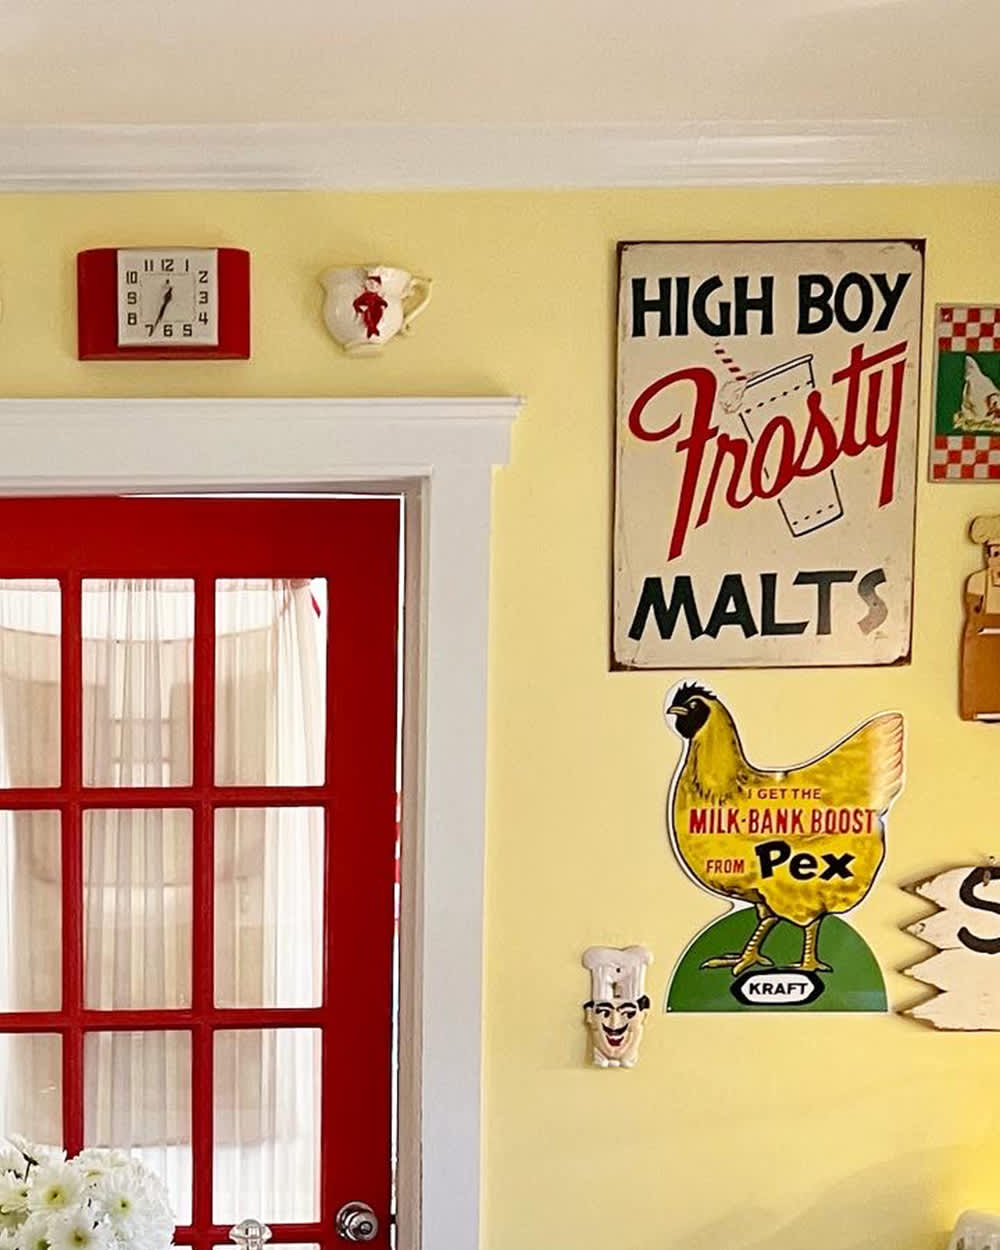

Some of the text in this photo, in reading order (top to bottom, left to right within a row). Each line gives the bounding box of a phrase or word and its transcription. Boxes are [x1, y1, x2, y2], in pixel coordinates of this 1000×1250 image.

[144, 259, 154, 272] 11
[161, 259, 174, 272] 12
[126, 271, 138, 284] 10
[198, 271, 209, 284] 2
[127, 292, 137, 305] 9
[198, 291, 209, 304] 3
[630, 272, 912, 338] HIGH BOY
[127, 313, 137, 326] 8
[198, 312, 209, 325] 4
[145, 324, 193, 337] 7 6 5
[627, 340, 908, 562] Frosty
[627, 568, 888, 641] MALTS
[757, 788, 788, 800] GET
[792, 788, 822, 800] THE
[810, 808, 876, 834] BOOST
[706, 840, 856, 880] FROM Pex
[749, 983, 808, 995] KRAFT
